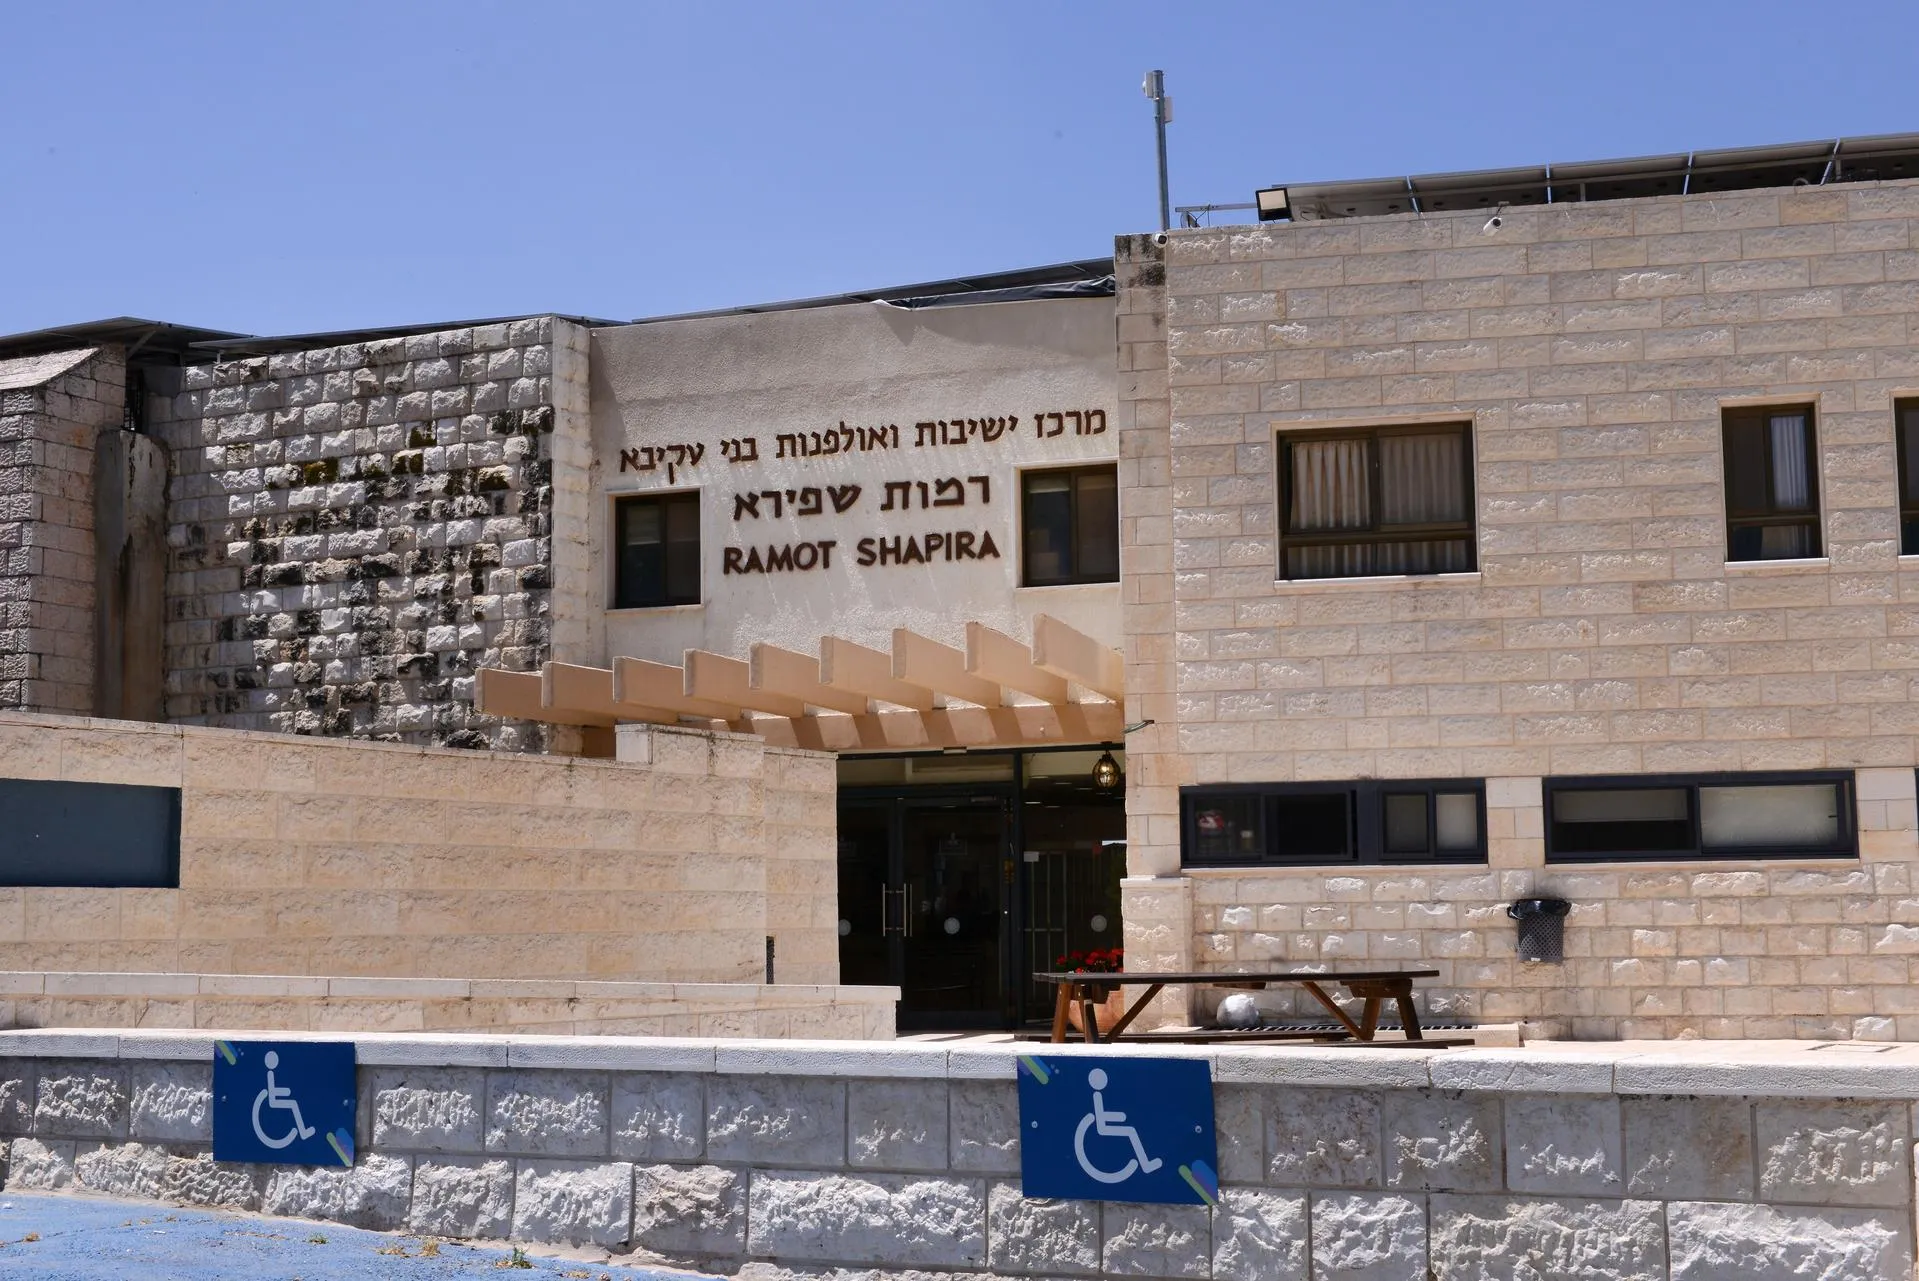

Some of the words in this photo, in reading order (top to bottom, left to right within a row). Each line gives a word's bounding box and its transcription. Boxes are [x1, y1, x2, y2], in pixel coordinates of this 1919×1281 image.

[776, 420, 900, 460] ואולפנות
[914, 415, 1019, 448] ישיבות
[1034, 408, 1107, 440] מרכז
[618, 442, 706, 486] עקיבא
[720, 437, 760, 464] בני
[732, 483, 863, 522] שפירא
[880, 474, 992, 513] רמות
[723, 538, 838, 577] RAMOT
[856, 529, 1001, 568] SHAPIRA
